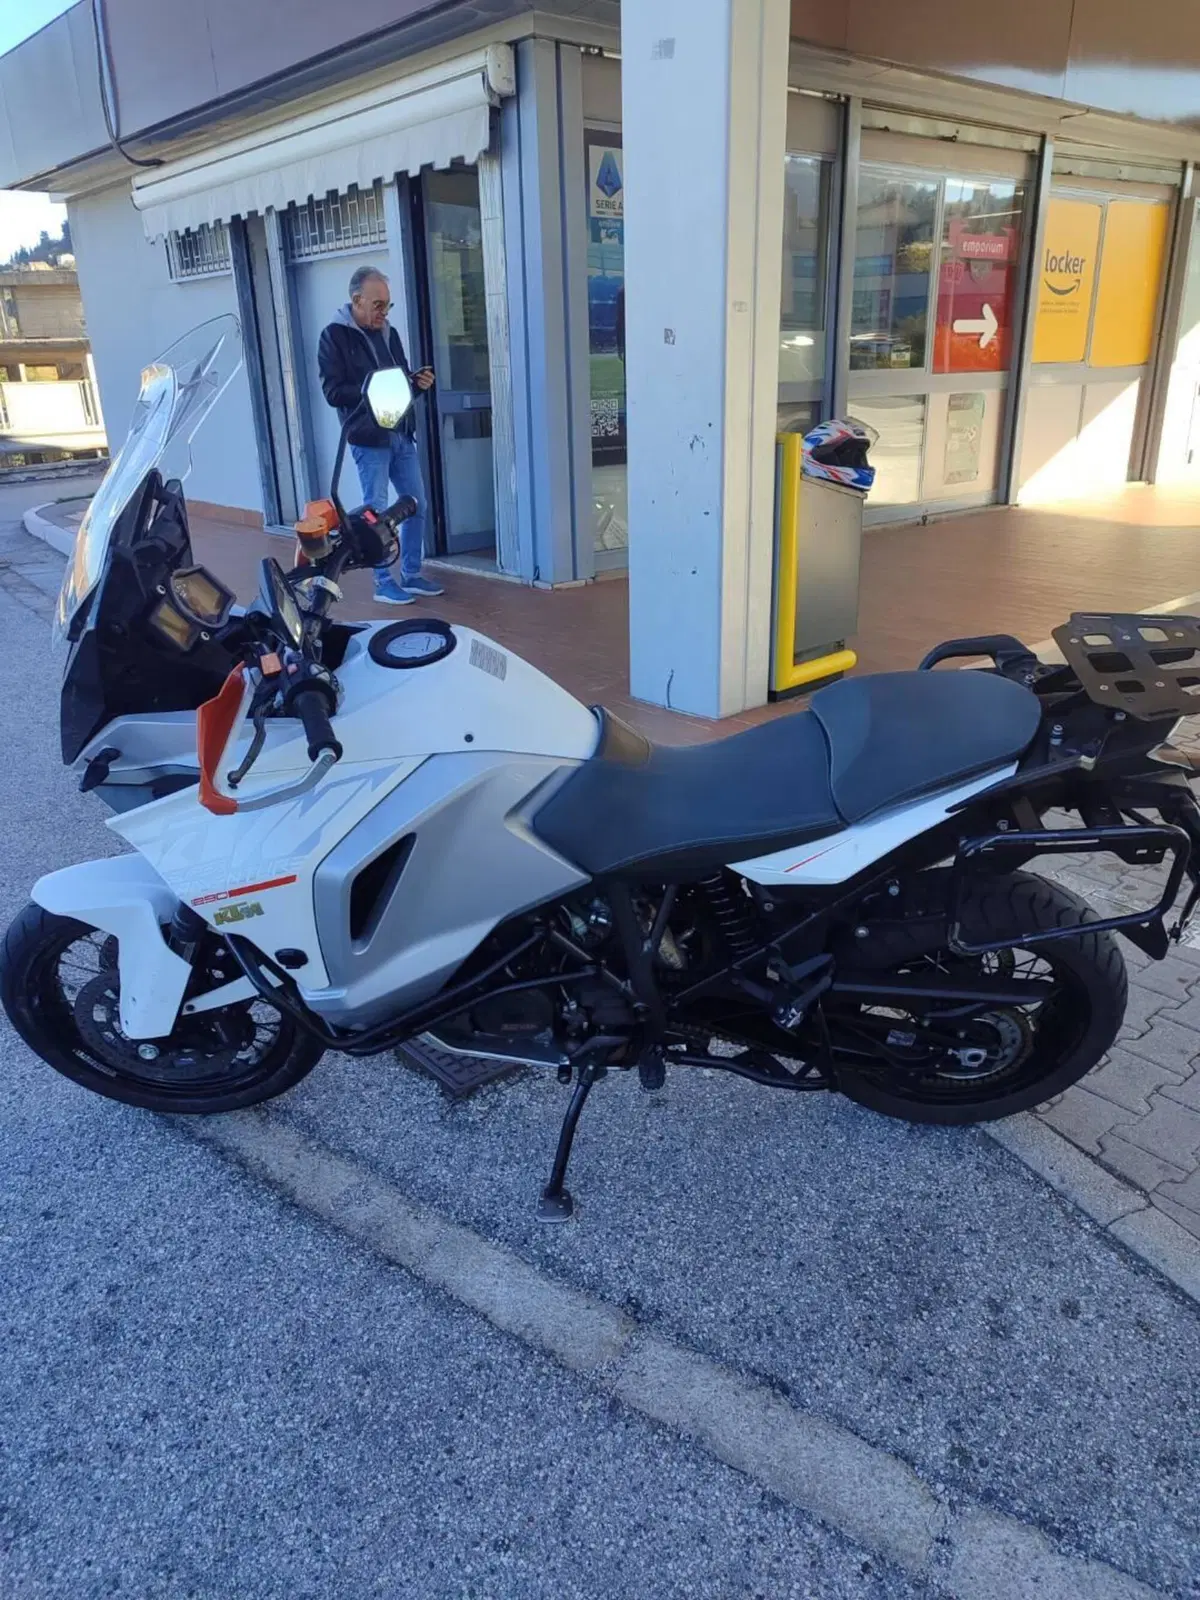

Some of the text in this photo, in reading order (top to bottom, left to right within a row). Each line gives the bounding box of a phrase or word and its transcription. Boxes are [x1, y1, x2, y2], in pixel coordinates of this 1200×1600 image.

[595, 199, 617, 209] SERIE
[962, 239, 1004, 256] emporium
[1045, 248, 1086, 274] locker
[213, 902, 265, 926] KTM
